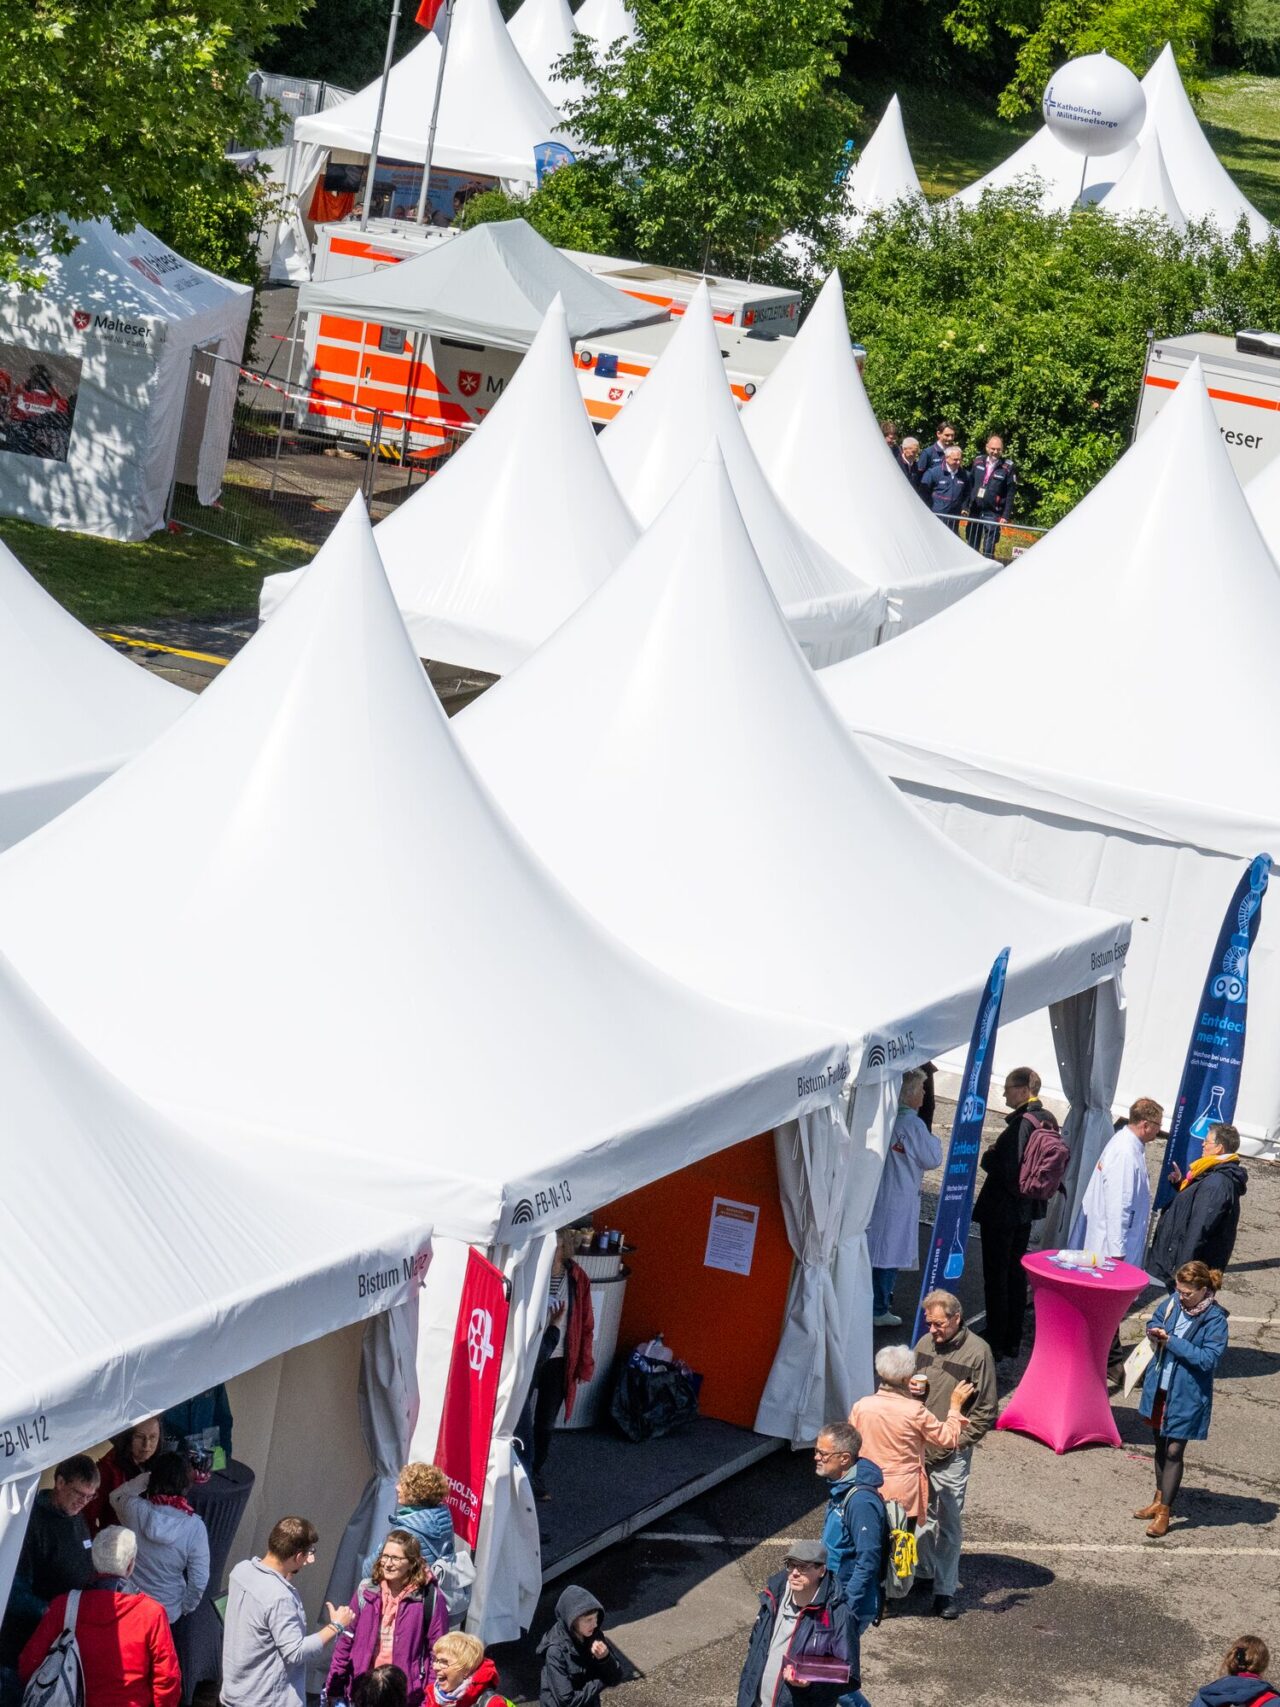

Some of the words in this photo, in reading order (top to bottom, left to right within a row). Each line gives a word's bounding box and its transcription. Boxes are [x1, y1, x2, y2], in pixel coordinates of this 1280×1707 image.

[1056, 102, 1102, 117] Katholische
[1056, 111, 1119, 128] Militärseelsorge
[94, 315, 152, 338] Malteser
[1090, 949, 1114, 972] Bistum
[887, 1031, 915, 1062] FB-N-15
[1196, 1031, 1229, 1048] mehr.
[1211, 1053, 1219, 1062] bei
[1219, 1055, 1230, 1064] uns
[797, 1069, 827, 1098] Bistum
[1173, 1105, 1185, 1137] BISTUM
[949, 1161, 969, 1174] mehr.
[534, 1180, 572, 1217] FB-N-13
[929, 1248, 941, 1284] BISTUM
[358, 1267, 400, 1299] Bistum
